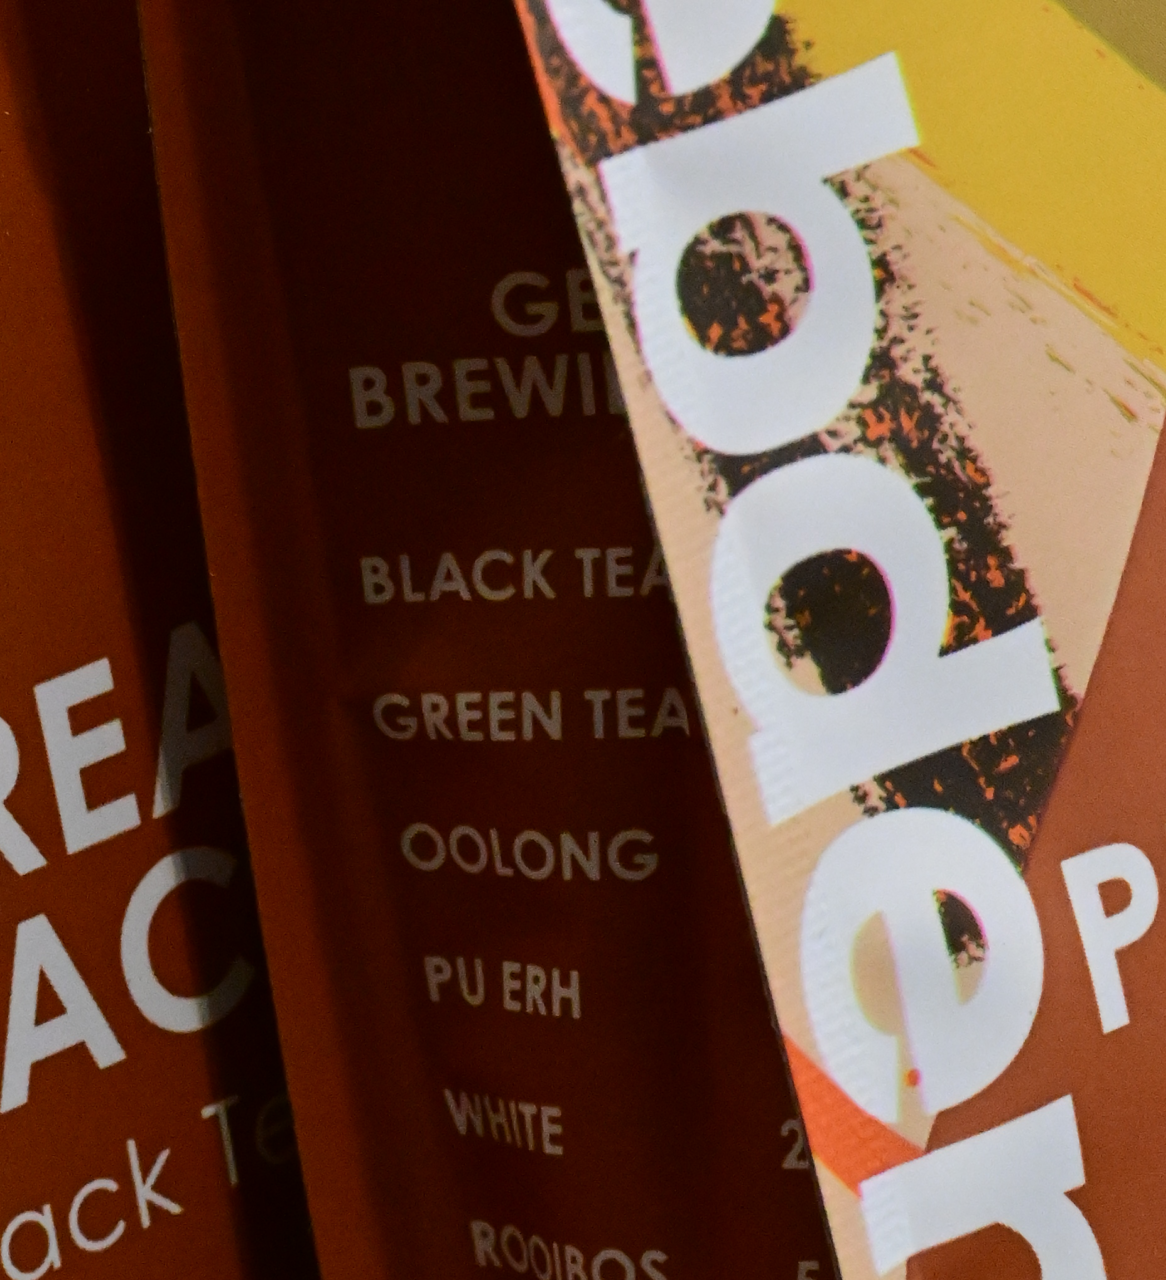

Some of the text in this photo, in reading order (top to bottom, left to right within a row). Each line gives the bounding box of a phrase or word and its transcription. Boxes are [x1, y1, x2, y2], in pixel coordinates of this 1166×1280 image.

[360, 546, 676, 605] BLACK TEA
[372, 686, 692, 742] GREEN TEA
[400, 821, 660, 882] OOLONG
[0, 845, 256, 1114] AC
[423, 955, 582, 1020] PU ERH
[443, 1088, 564, 1156] WHITE
